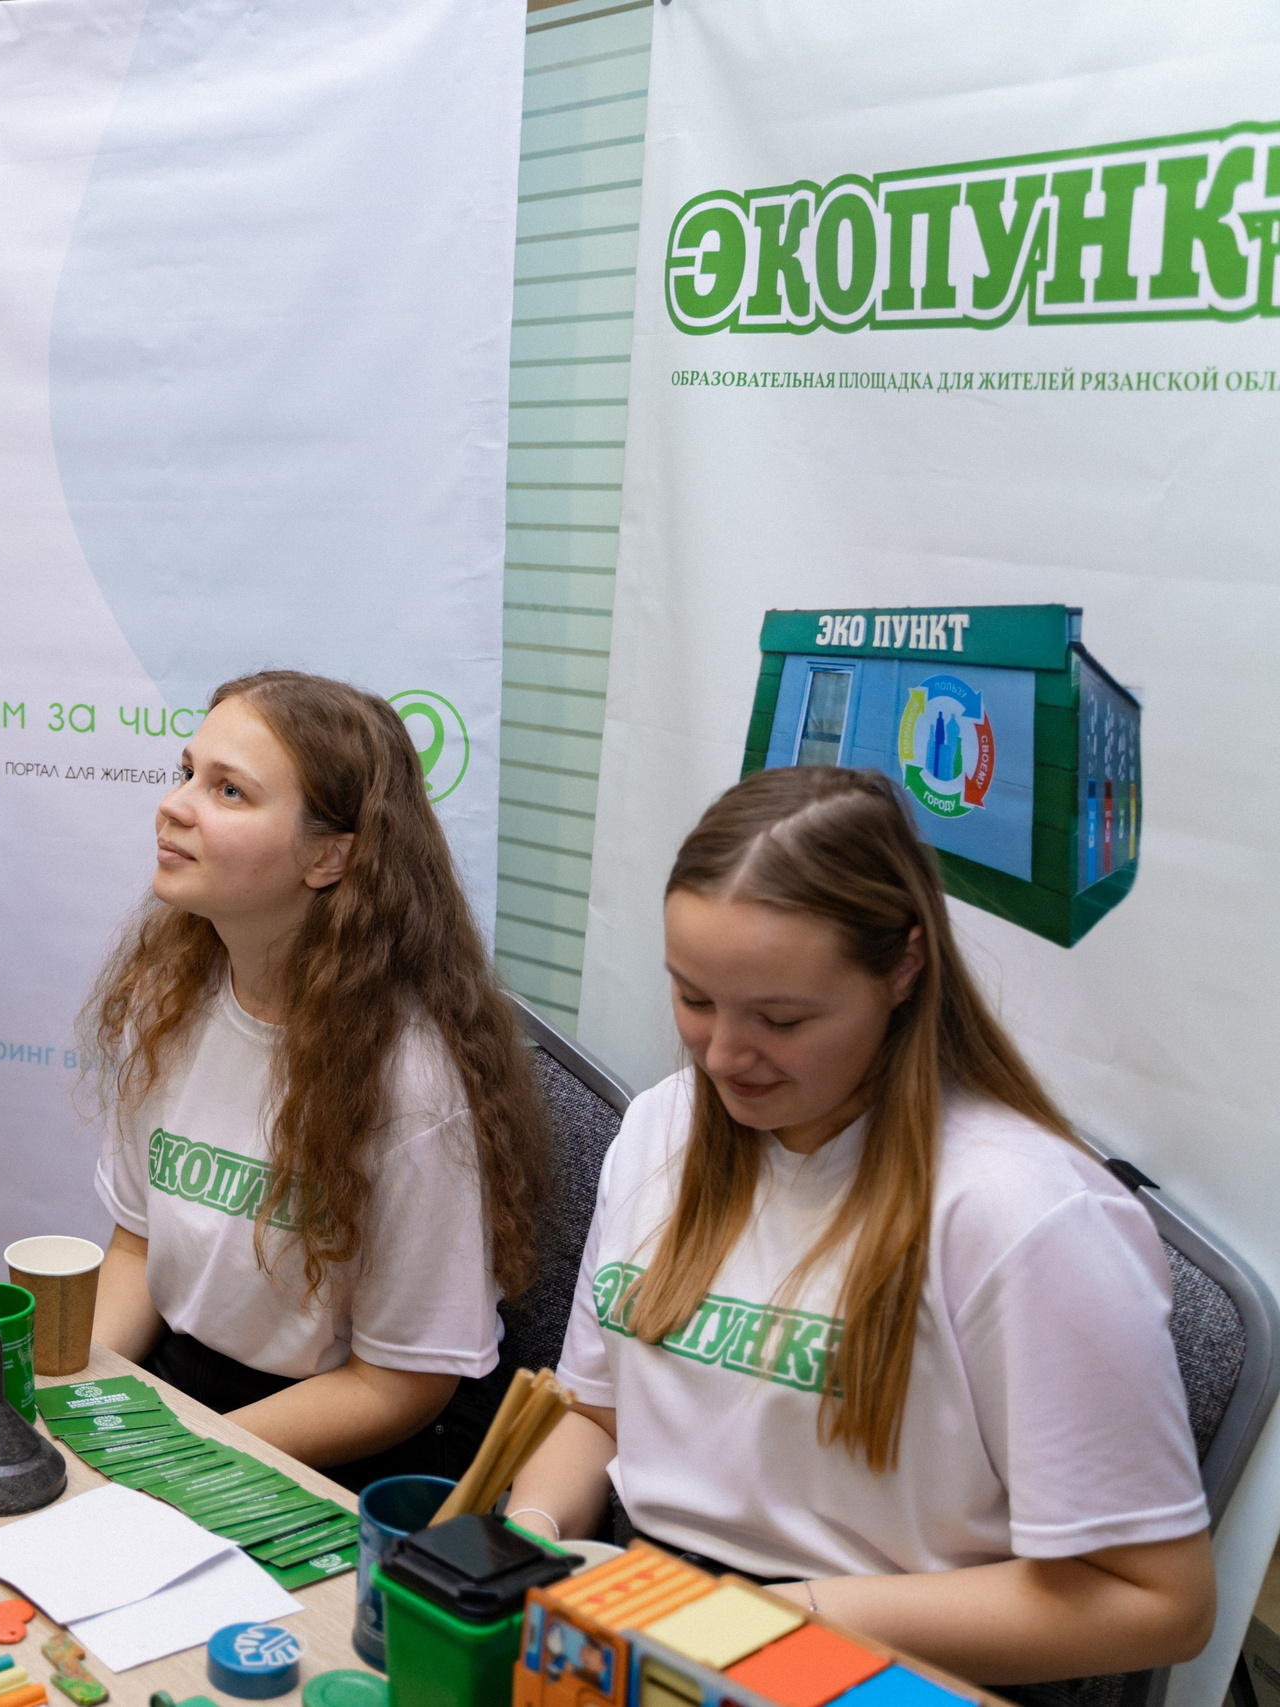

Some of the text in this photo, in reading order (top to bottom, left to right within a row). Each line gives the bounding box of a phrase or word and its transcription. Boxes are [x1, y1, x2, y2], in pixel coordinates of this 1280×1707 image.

[664, 121, 1280, 335] ЭКОПУНК
[671, 366, 1280, 393] ОБРАЗОВАТЕЛЬНАЯ ПЛОЩАДКА ДЛЯ ЖИТЕЛЕЙ РЯЗАНСКОЙ ОБЛ
[816, 613, 970, 652] ЭКО ПУНКТ
[934, 681, 967, 699] ПОЛЬЗУ
[48, 702, 95, 733] за
[5, 762, 59, 778] ПОРТАЛ
[65, 766, 95, 780] ДЛЯ
[100, 767, 166, 785] ЖИТЕЛЕЙ
[976, 735, 990, 789] СВОЕМУ
[923, 791, 956, 813] ГОРОДУ
